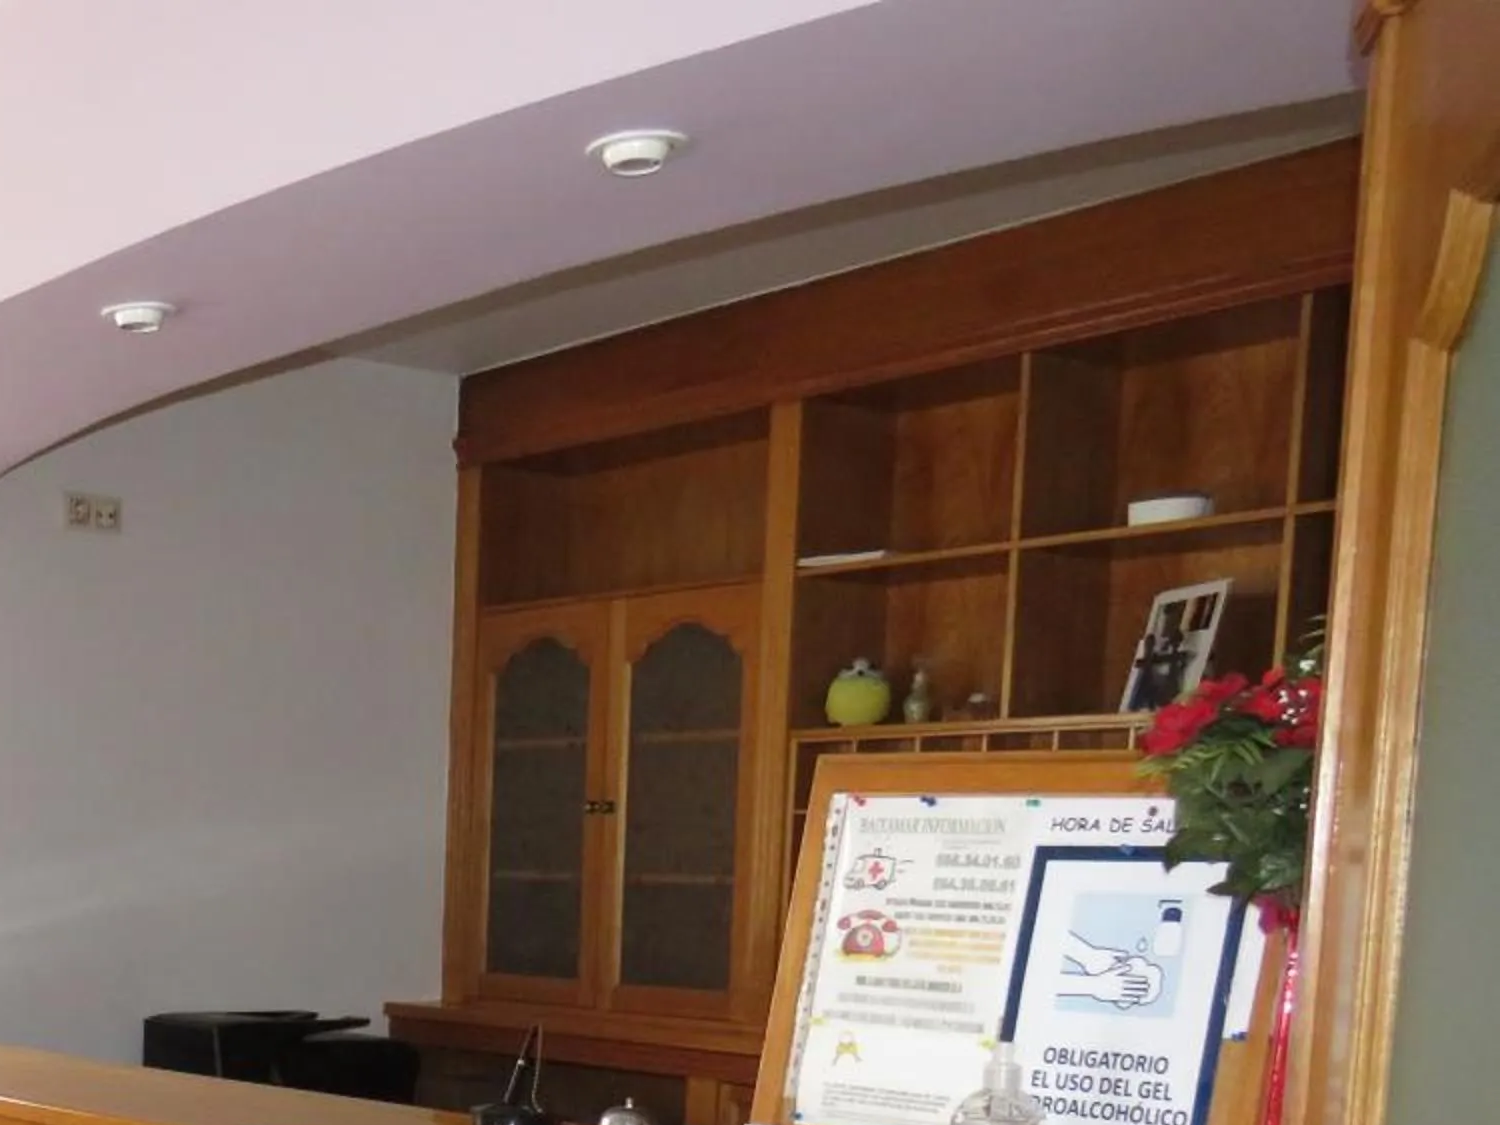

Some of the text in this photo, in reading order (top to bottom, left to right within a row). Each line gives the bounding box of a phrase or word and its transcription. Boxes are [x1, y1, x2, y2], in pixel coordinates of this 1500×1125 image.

[1050, 817, 1177, 833] HORA DE SAL
[1043, 1047, 1169, 1075] OBLIGATORIO
[1031, 1069, 1172, 1101] EL USO DEL GEL
